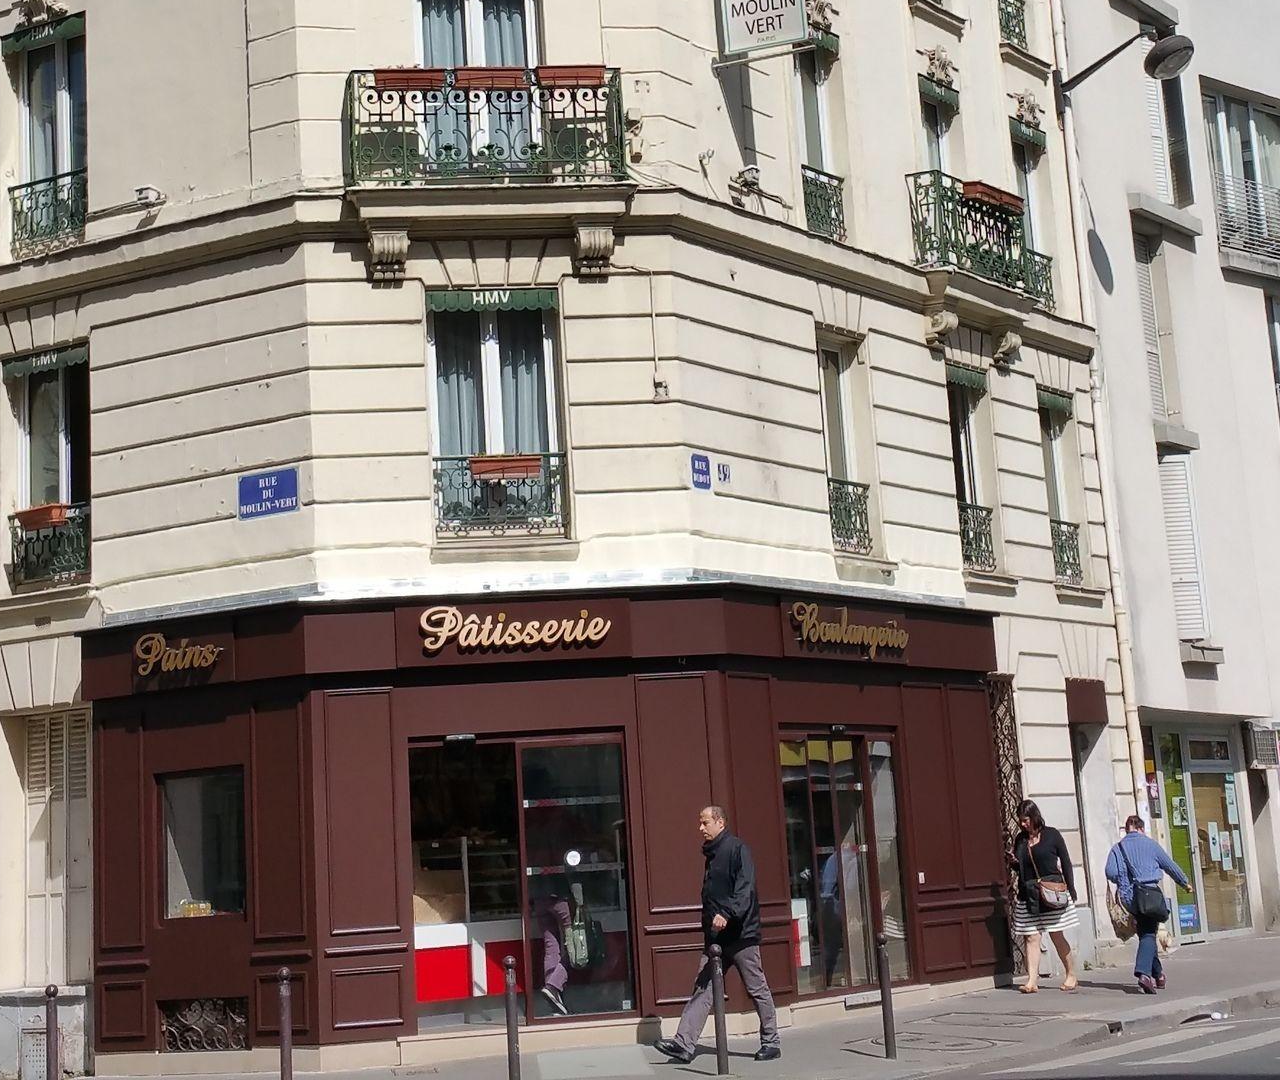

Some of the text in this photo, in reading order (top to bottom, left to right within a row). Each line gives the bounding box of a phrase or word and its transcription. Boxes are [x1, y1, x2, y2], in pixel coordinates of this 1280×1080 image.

[745, 14, 784, 35] VERT
[472, 290, 511, 305] HMV
[259, 476, 278, 488] RUE
[262, 489, 275, 500] DU
[240, 497, 297, 515] MOULIN-VERT
[420, 606, 611, 650] Pâtisserie
[792, 601, 909, 661] Boulangerie
[135, 633, 221, 676] Pains
